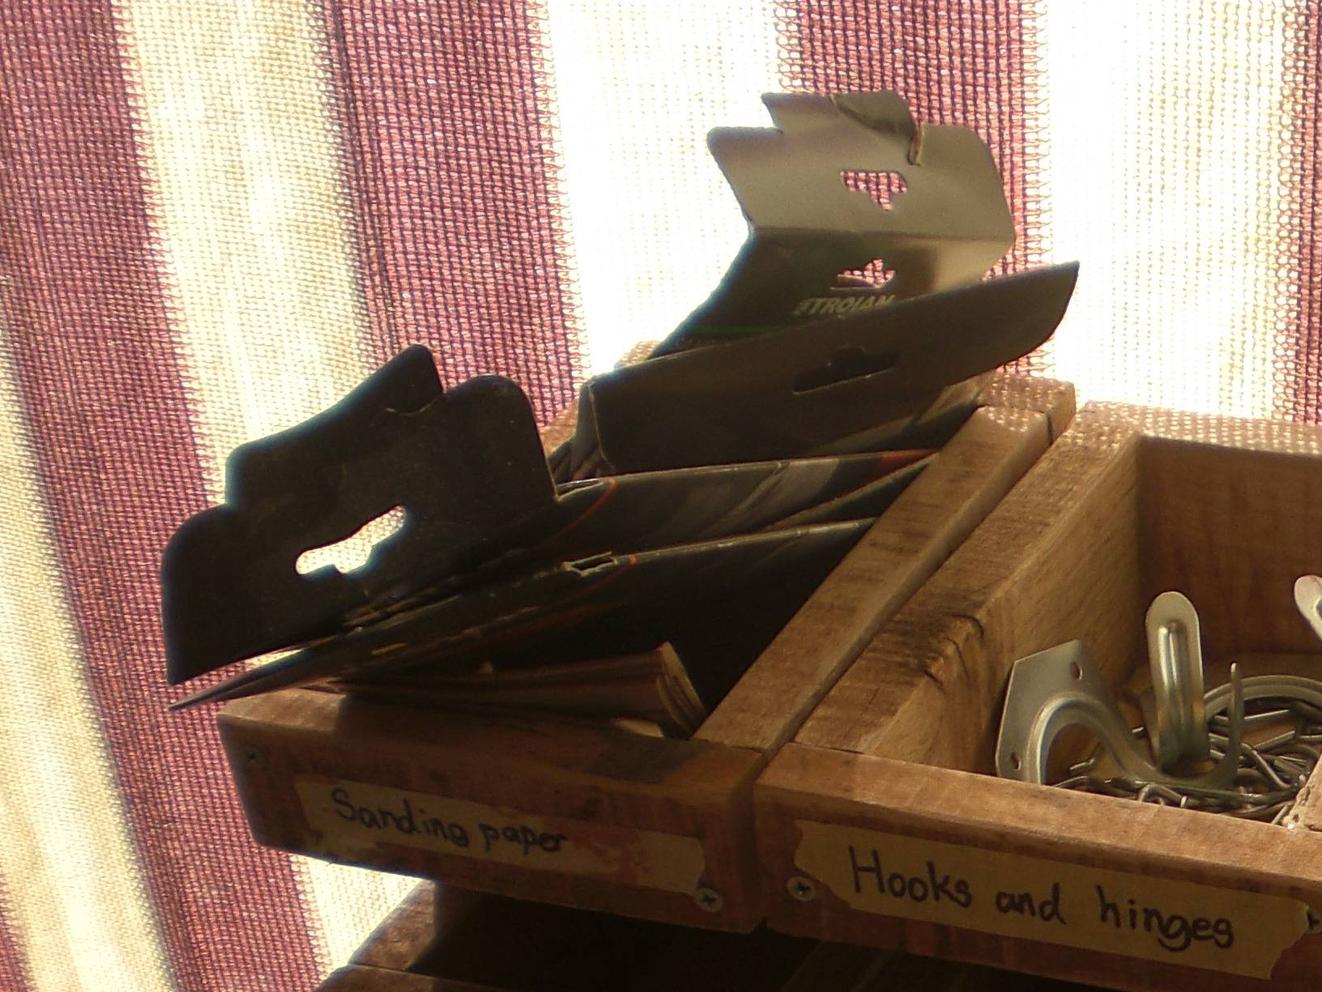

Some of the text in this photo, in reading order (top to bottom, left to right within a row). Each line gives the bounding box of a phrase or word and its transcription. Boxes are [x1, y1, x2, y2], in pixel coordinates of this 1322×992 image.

[332, 788, 569, 856] Sanding paper
[849, 846, 1234, 951] Hooks and hinges
